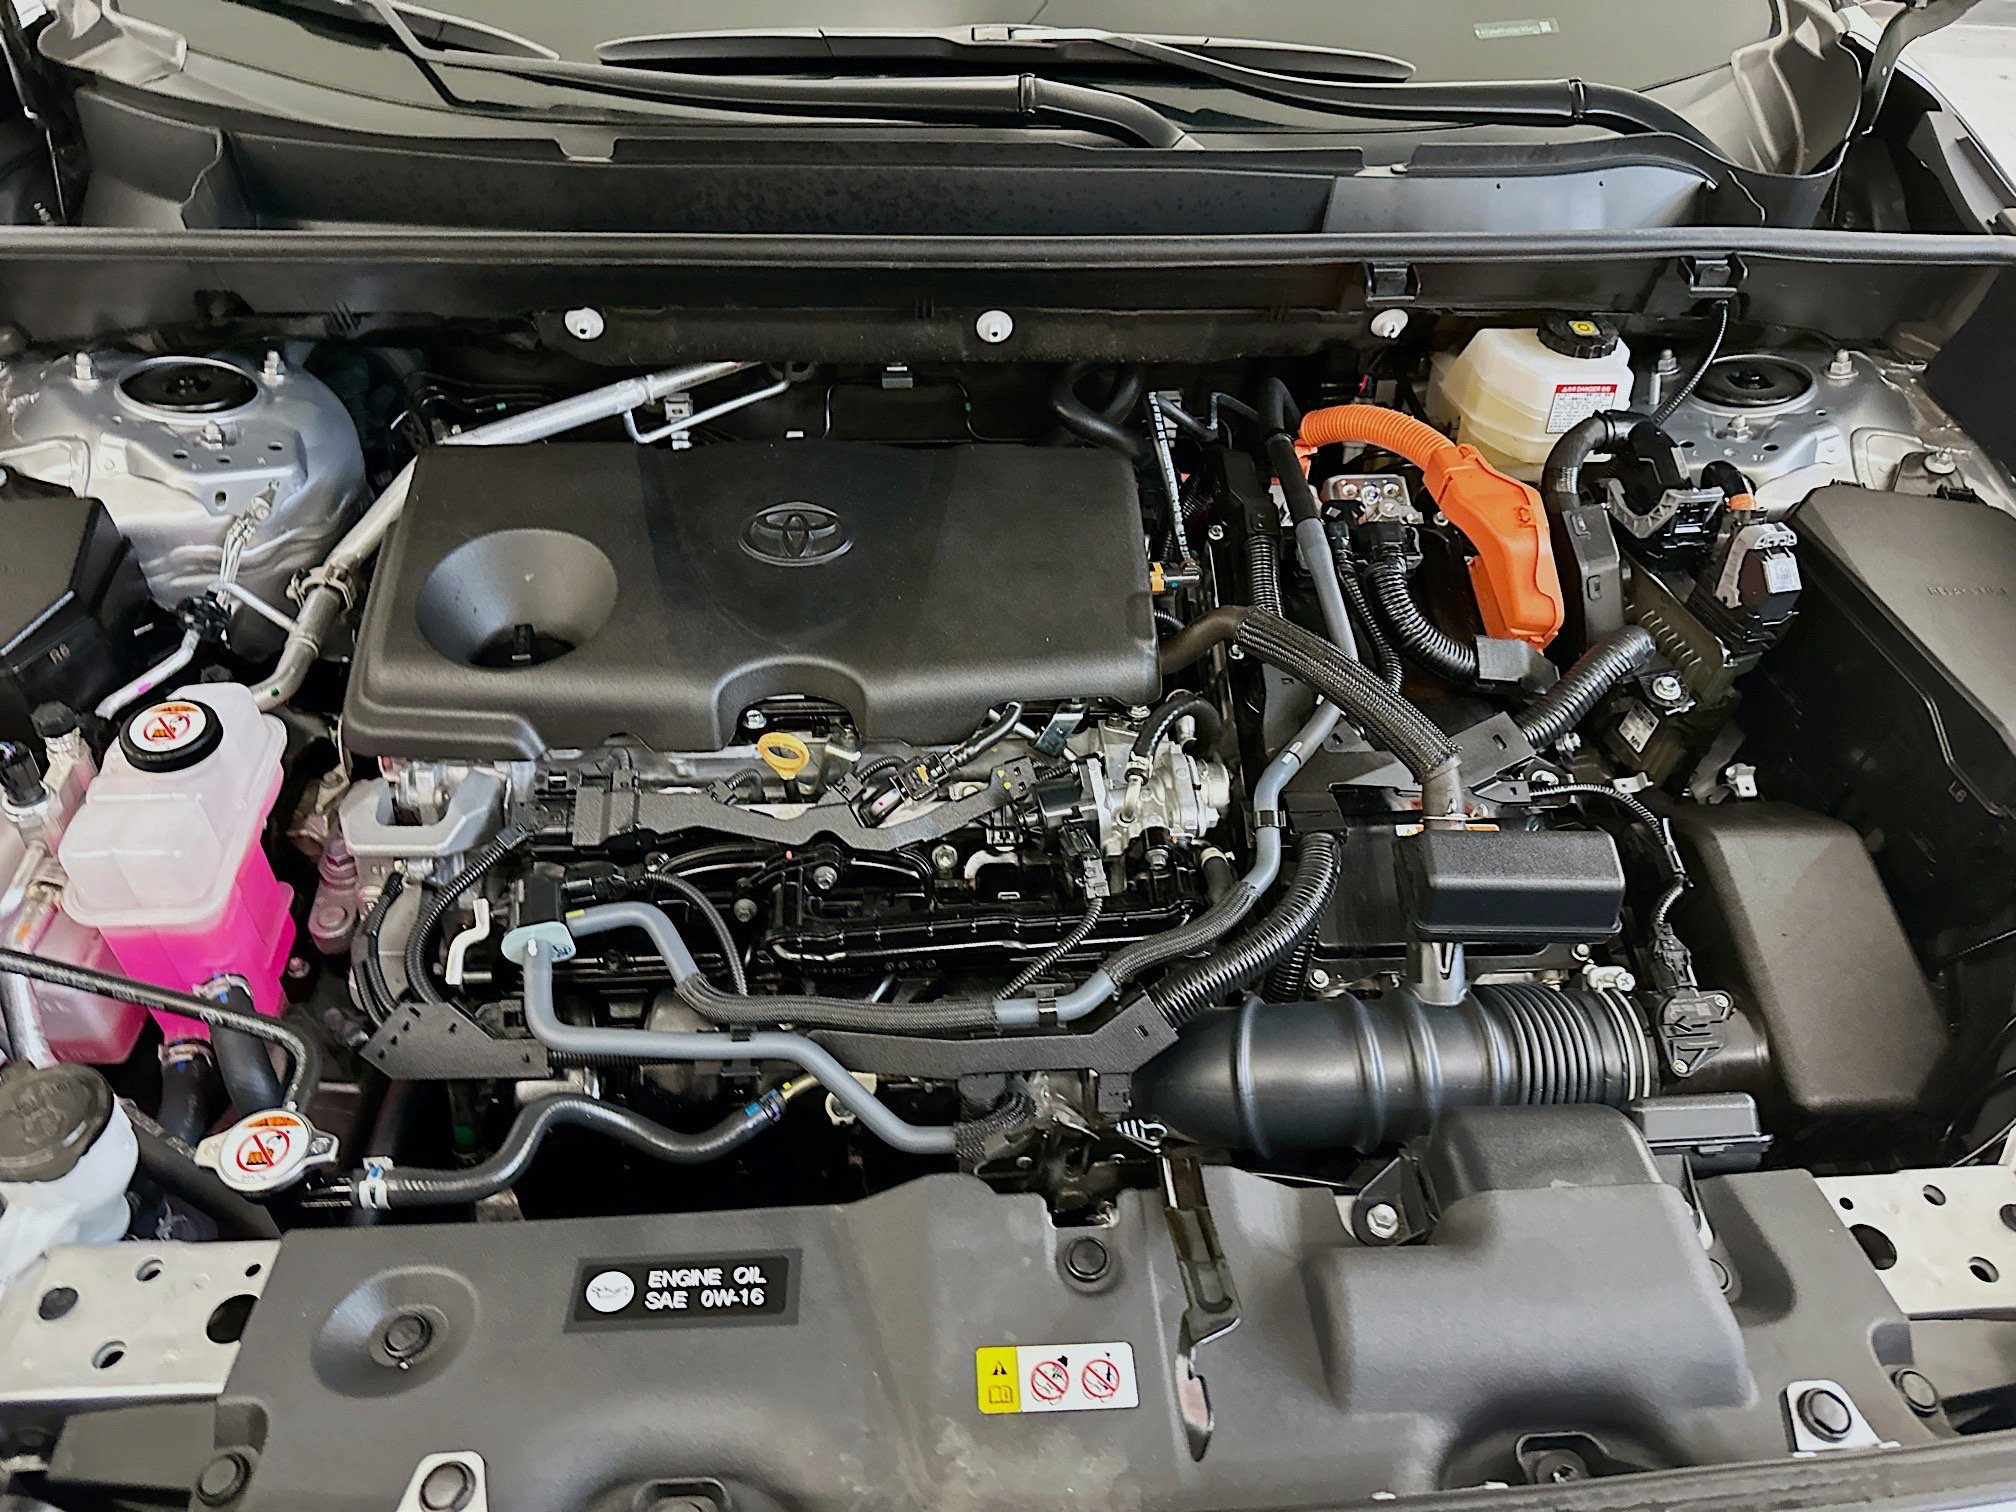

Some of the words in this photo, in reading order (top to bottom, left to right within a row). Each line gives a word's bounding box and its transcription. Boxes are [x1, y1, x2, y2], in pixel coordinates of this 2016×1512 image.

[1577, 385, 1601, 393] DANGER
[647, 1267, 723, 1288] ENGINE
[733, 1266, 767, 1284] OIL
[644, 1290, 688, 1310] SAE
[700, 1287, 765, 1307] 0W-16
